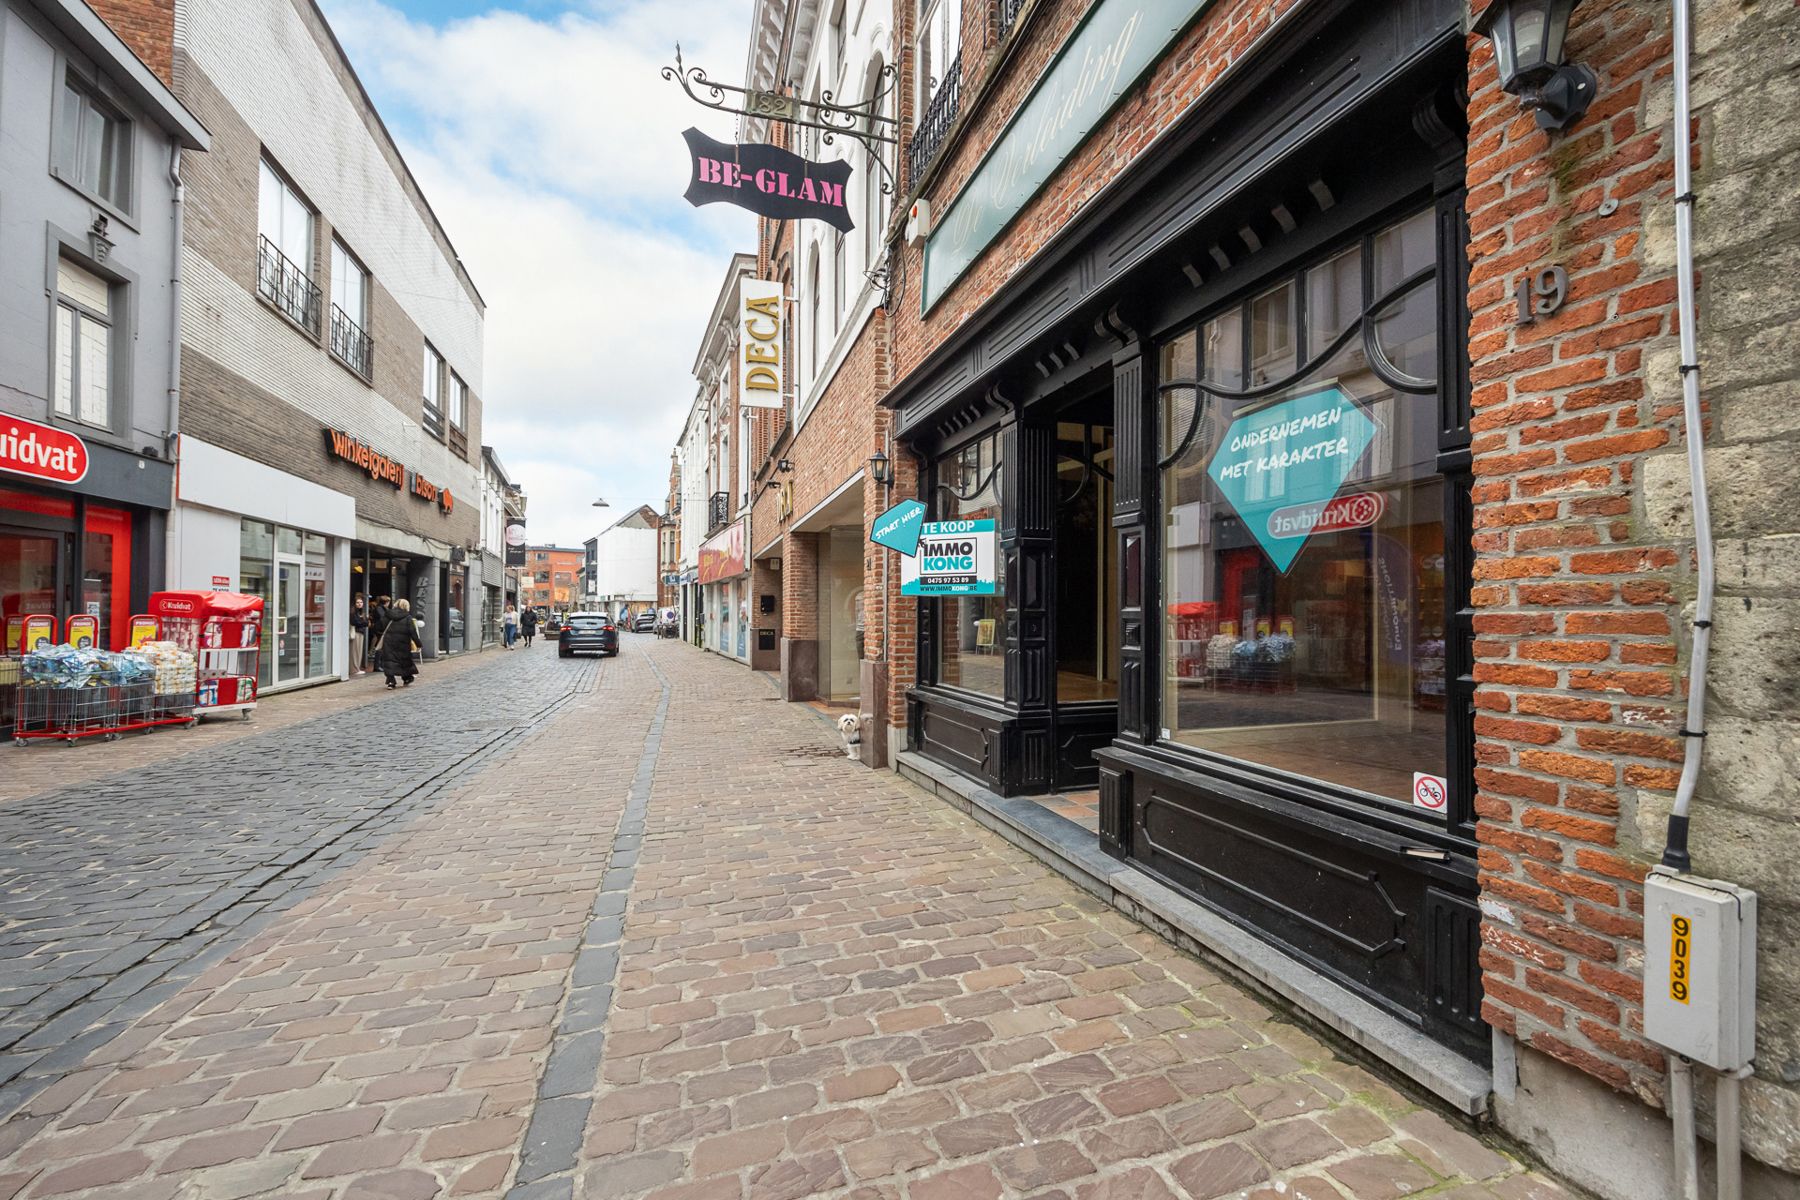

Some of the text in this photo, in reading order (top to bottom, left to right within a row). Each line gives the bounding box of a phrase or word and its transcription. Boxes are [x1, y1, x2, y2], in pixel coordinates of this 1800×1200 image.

[698, 157, 844, 207] BE-GLAM
[1515, 265, 1570, 325] 19
[745, 295, 780, 392] DECA
[1231, 407, 1342, 452] ONDERNEMEN
[332, 429, 438, 503] winkelgalerij bison
[1220, 437, 1349, 481] MET KARAKTER
[875, 506, 922, 540] START HIER
[923, 521, 976, 533] TE KOOP
[923, 542, 974, 557] IMMO
[923, 556, 974, 571] KONG
[1671, 917, 1690, 1001] 9039
